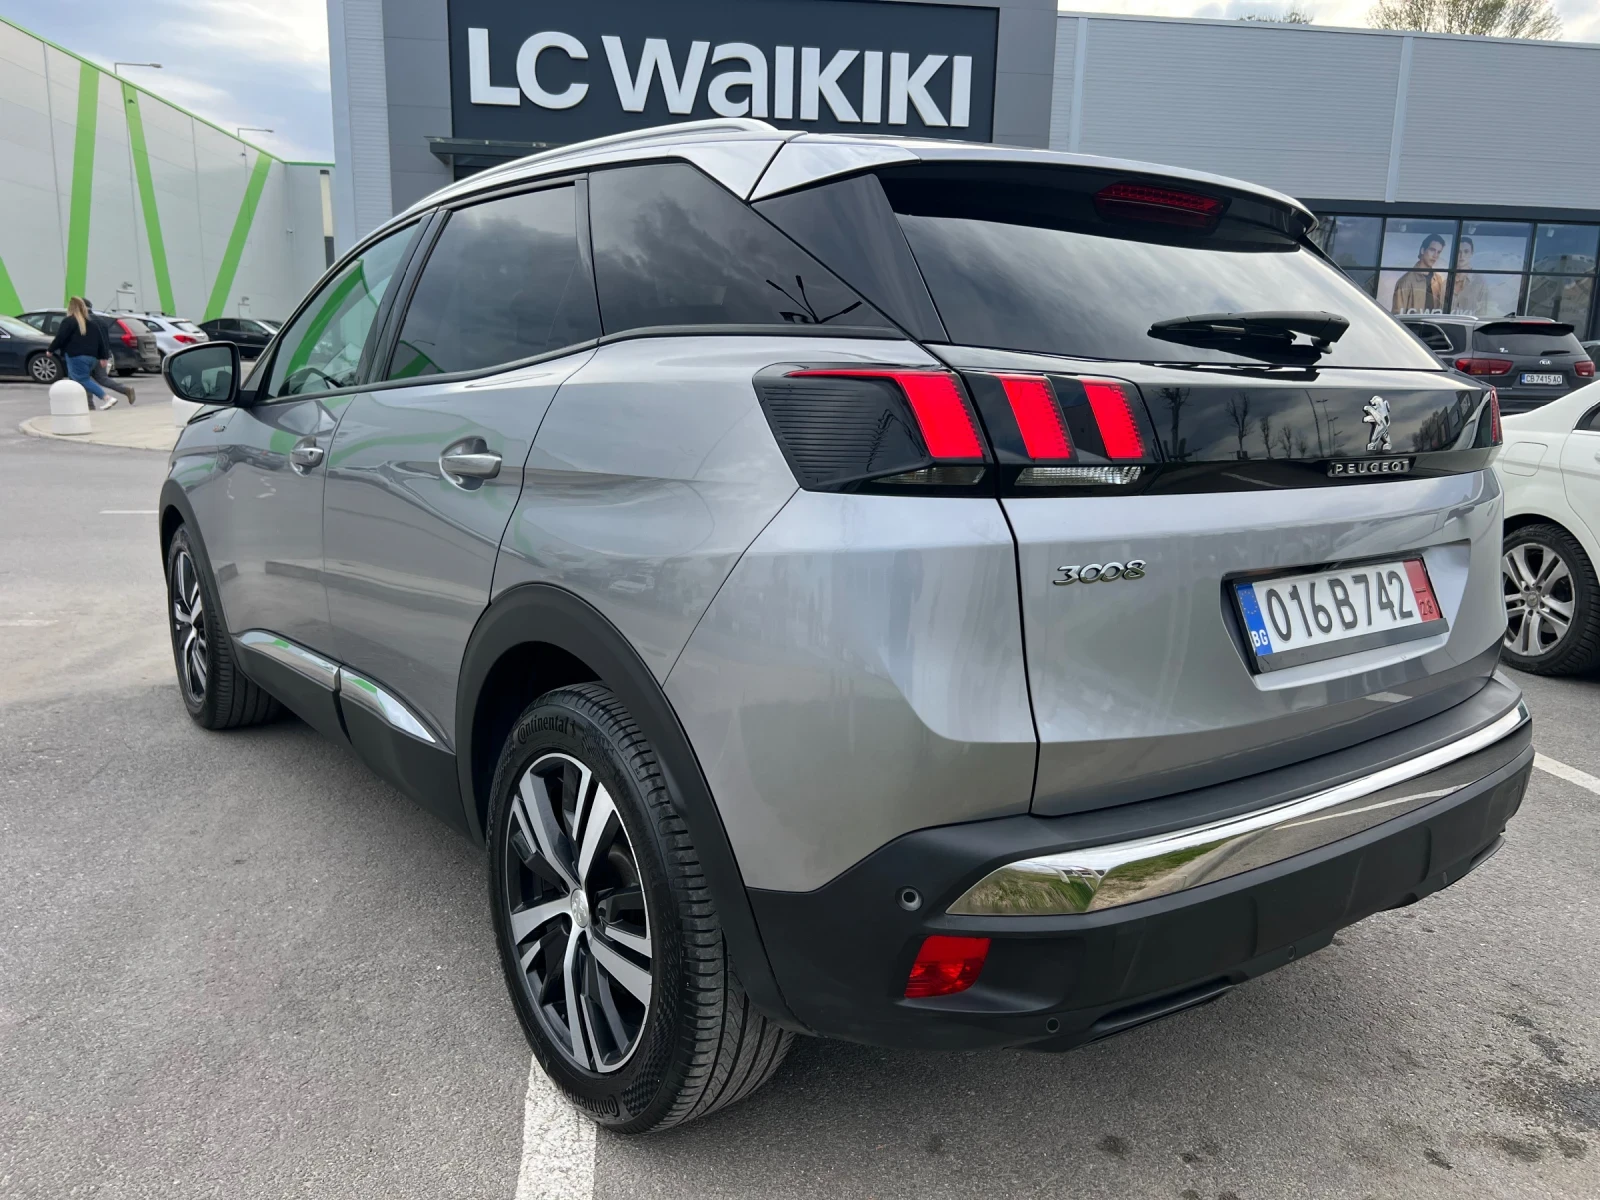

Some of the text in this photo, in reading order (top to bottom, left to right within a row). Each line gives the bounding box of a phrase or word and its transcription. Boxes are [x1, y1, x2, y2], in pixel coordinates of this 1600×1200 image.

[468, 27, 589, 110] LC
[1332, 459, 1409, 475] PEUGEOT
[1052, 559, 1147, 586] 3008
[1266, 571, 1413, 642] 016B742
[1252, 631, 1269, 647] BG
[517, 715, 570, 745] Continental
